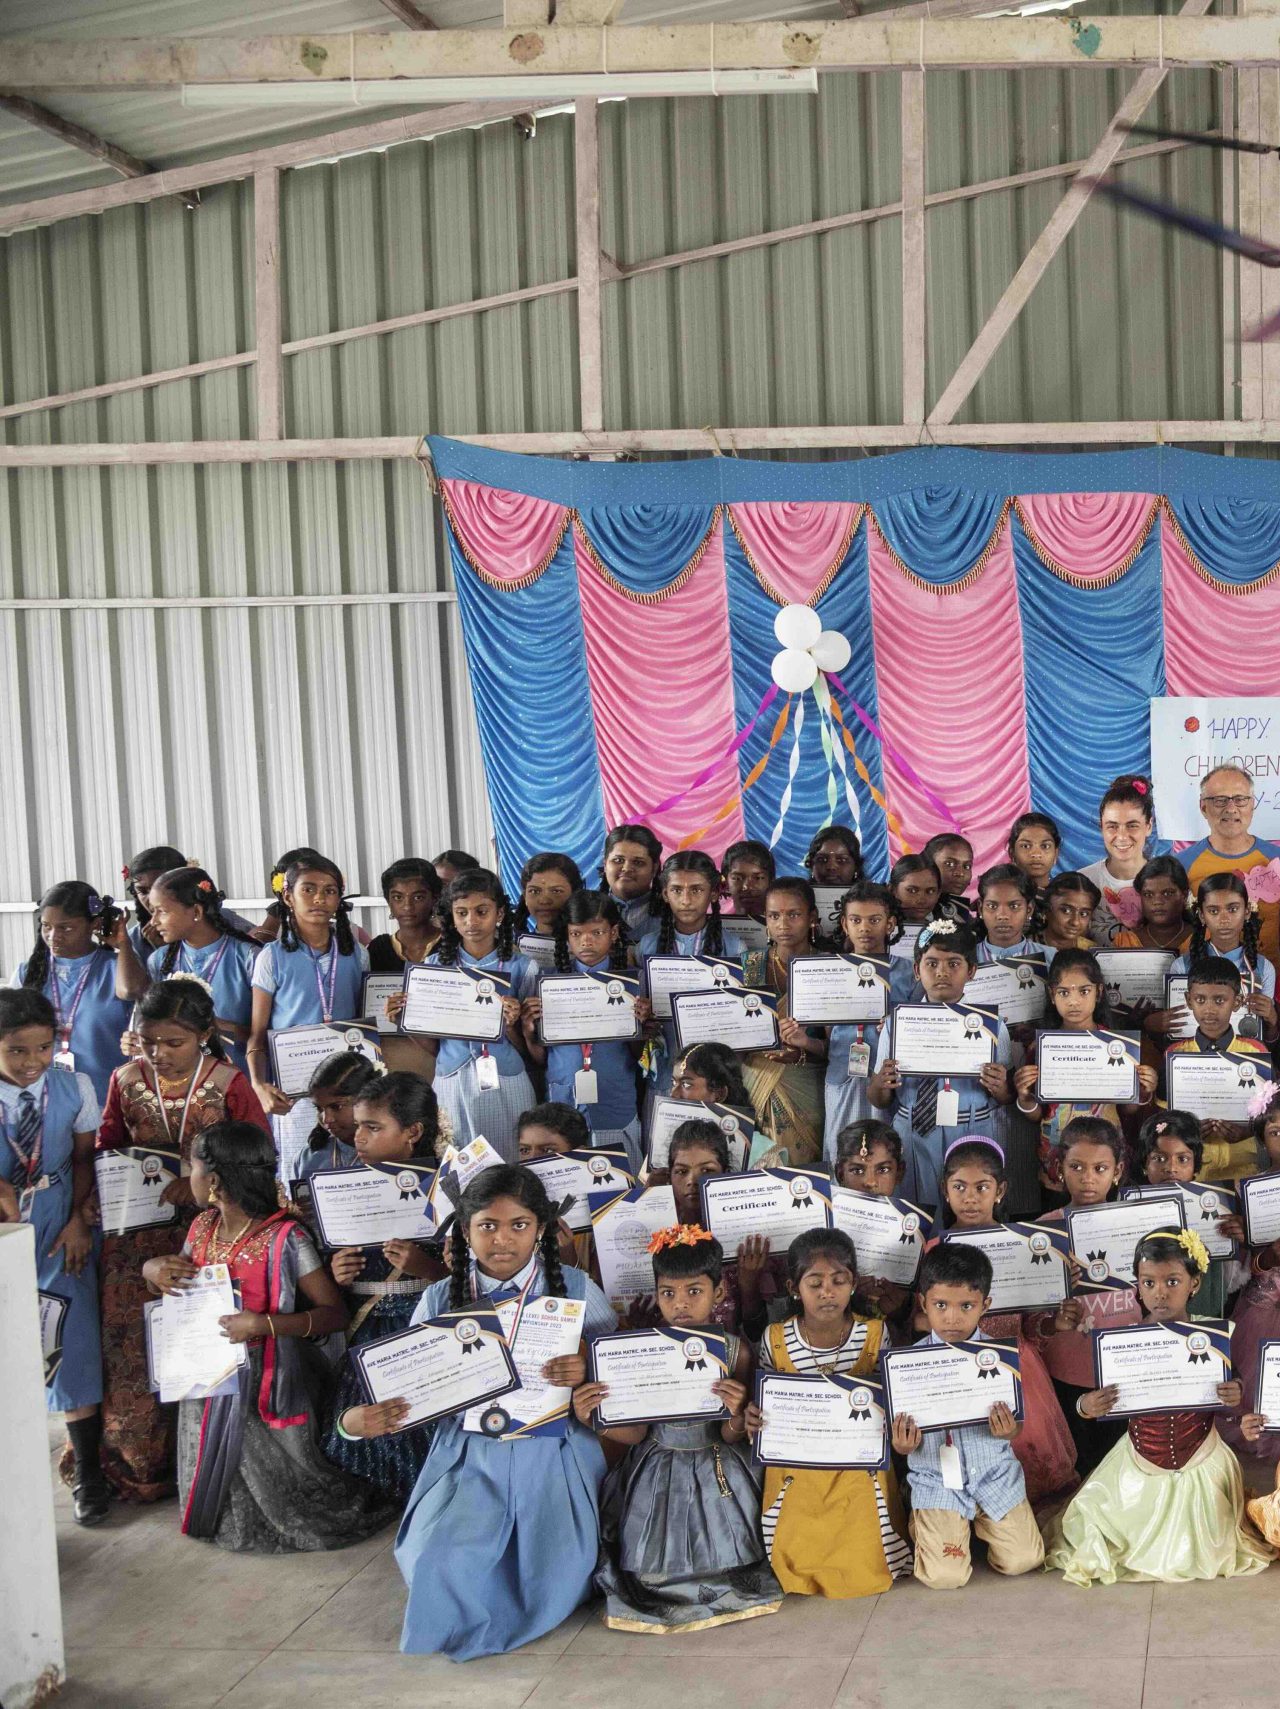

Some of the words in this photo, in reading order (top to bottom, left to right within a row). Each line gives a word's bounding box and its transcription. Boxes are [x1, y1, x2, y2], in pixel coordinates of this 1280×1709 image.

[1207, 717, 1271, 739] HAPPY
[288, 1048, 334, 1057] Certificate
[722, 1199, 777, 1212] Certificate
